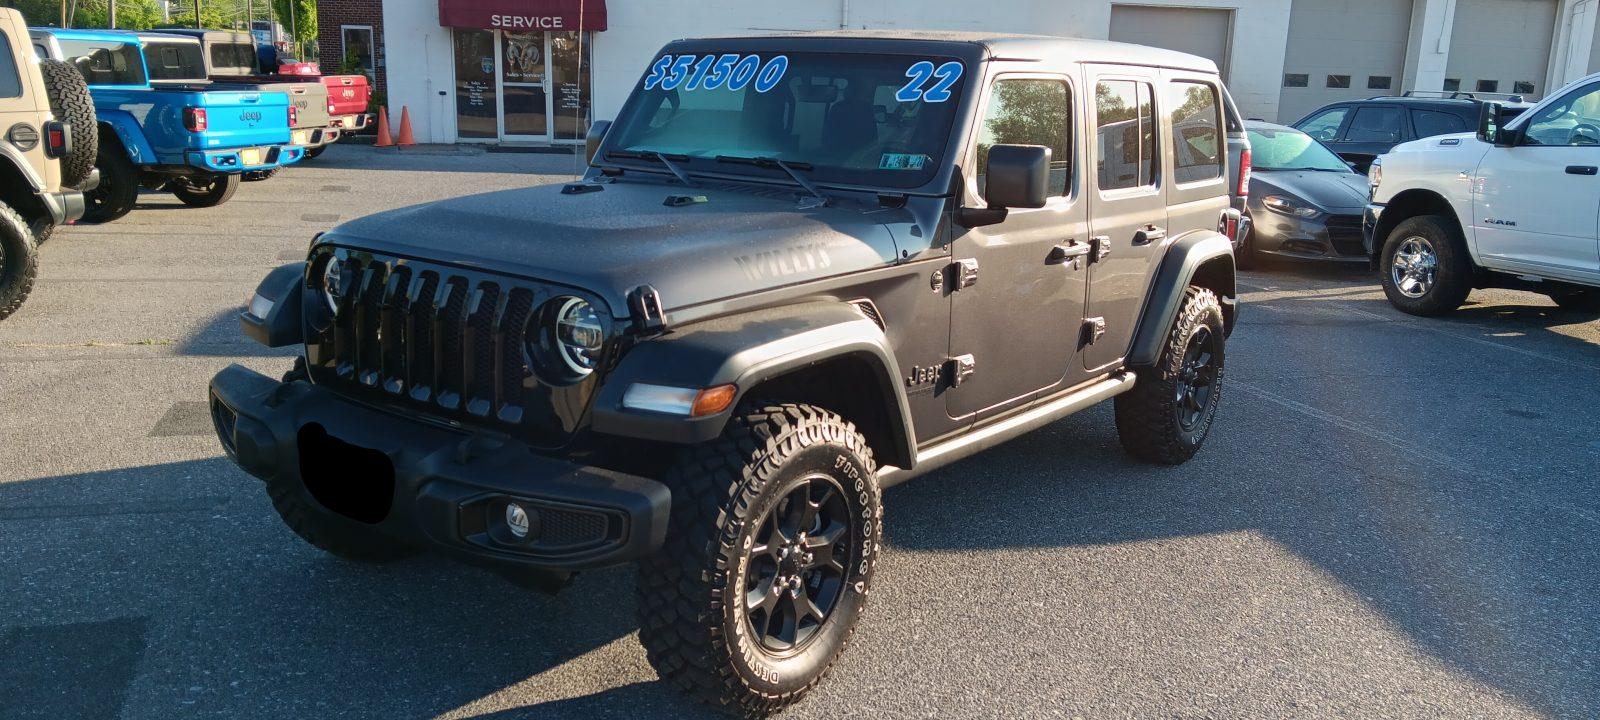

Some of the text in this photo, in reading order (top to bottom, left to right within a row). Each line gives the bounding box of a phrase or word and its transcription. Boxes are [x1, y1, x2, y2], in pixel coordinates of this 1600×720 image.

[491, 14, 563, 28] SERVICE
[644, 54, 789, 93] $51500
[895, 61, 964, 103] 22
[341, 88, 355, 98] Jeep
[239, 109, 262, 123] Jeep
[1484, 217, 1516, 227] RAM
[734, 243, 831, 281] WILLYS
[907, 364, 942, 386] Jeep
